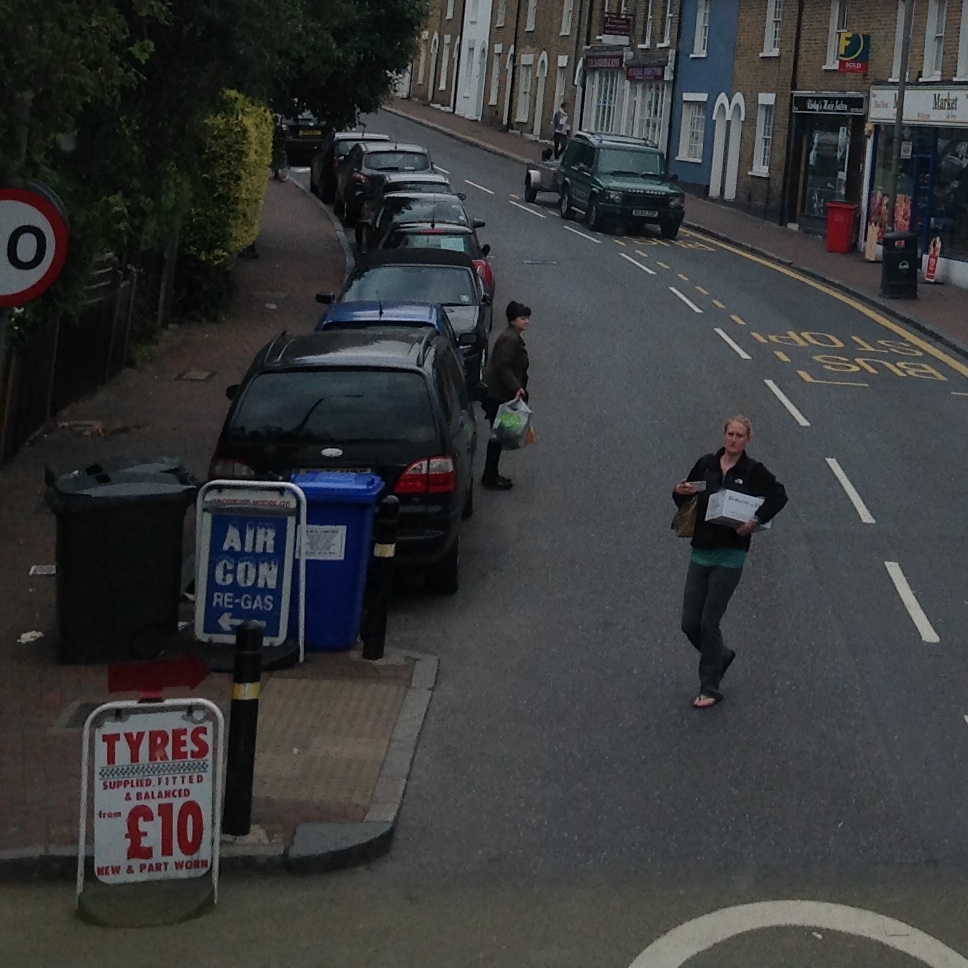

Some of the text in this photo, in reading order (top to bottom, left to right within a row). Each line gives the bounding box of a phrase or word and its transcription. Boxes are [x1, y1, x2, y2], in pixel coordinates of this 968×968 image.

[845, 61, 863, 70] SOLD
[932, 92, 959, 111] Market
[7, 225, 47, 270] 0
[768, 330, 925, 357] STOP
[812, 354, 949, 382] BUS
[222, 521, 277, 553] AIR
[214, 556, 279, 589] CON
[213, 592, 274, 611] RE-GAS
[102, 726, 210, 765] TYRES
[157, 774, 204, 787] FITTED
[124, 788, 190, 803] & BALANCED
[98, 810, 122, 819] from
[125, 799, 204, 860] £10
[96, 858, 209, 876] NEW & PART WORN
